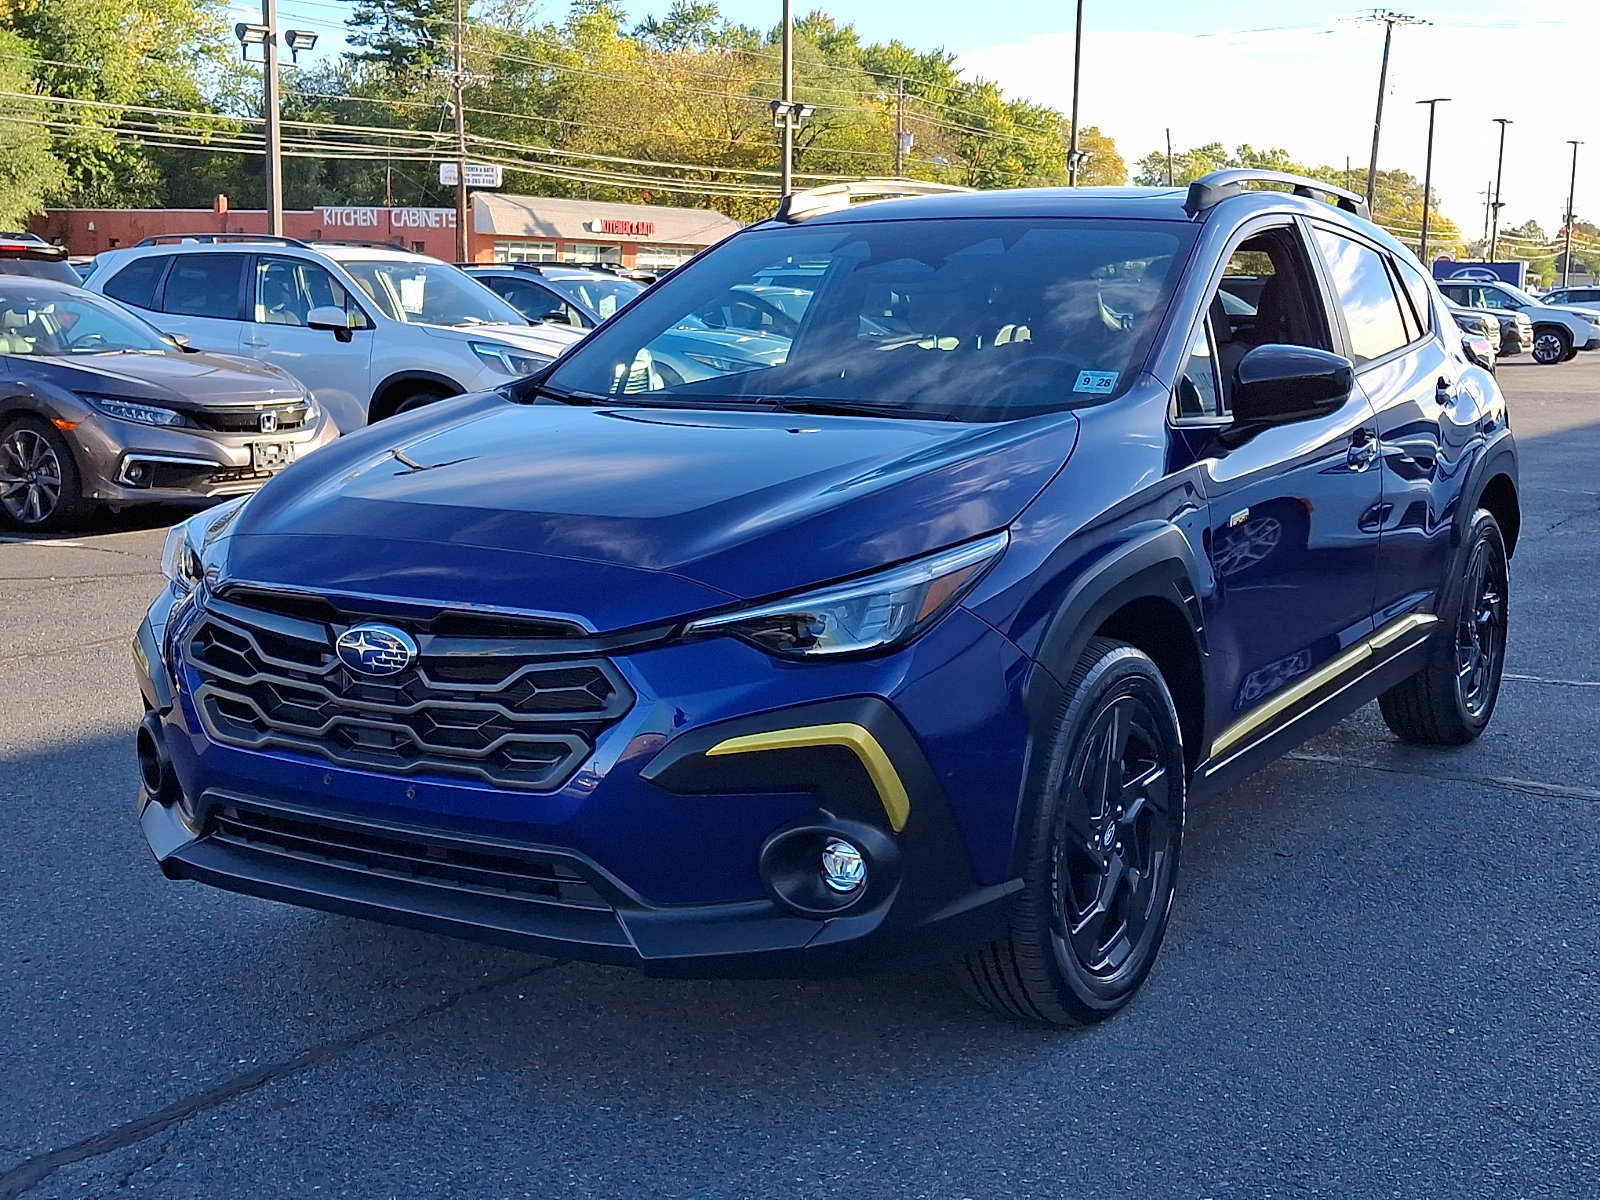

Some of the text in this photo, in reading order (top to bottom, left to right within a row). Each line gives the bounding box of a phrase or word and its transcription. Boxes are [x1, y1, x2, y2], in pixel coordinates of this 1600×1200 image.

[323, 209, 457, 228] KITCHEN CABINETS
[601, 219, 631, 234] KITCHEN
[1082, 377, 1112, 387] 9 28
